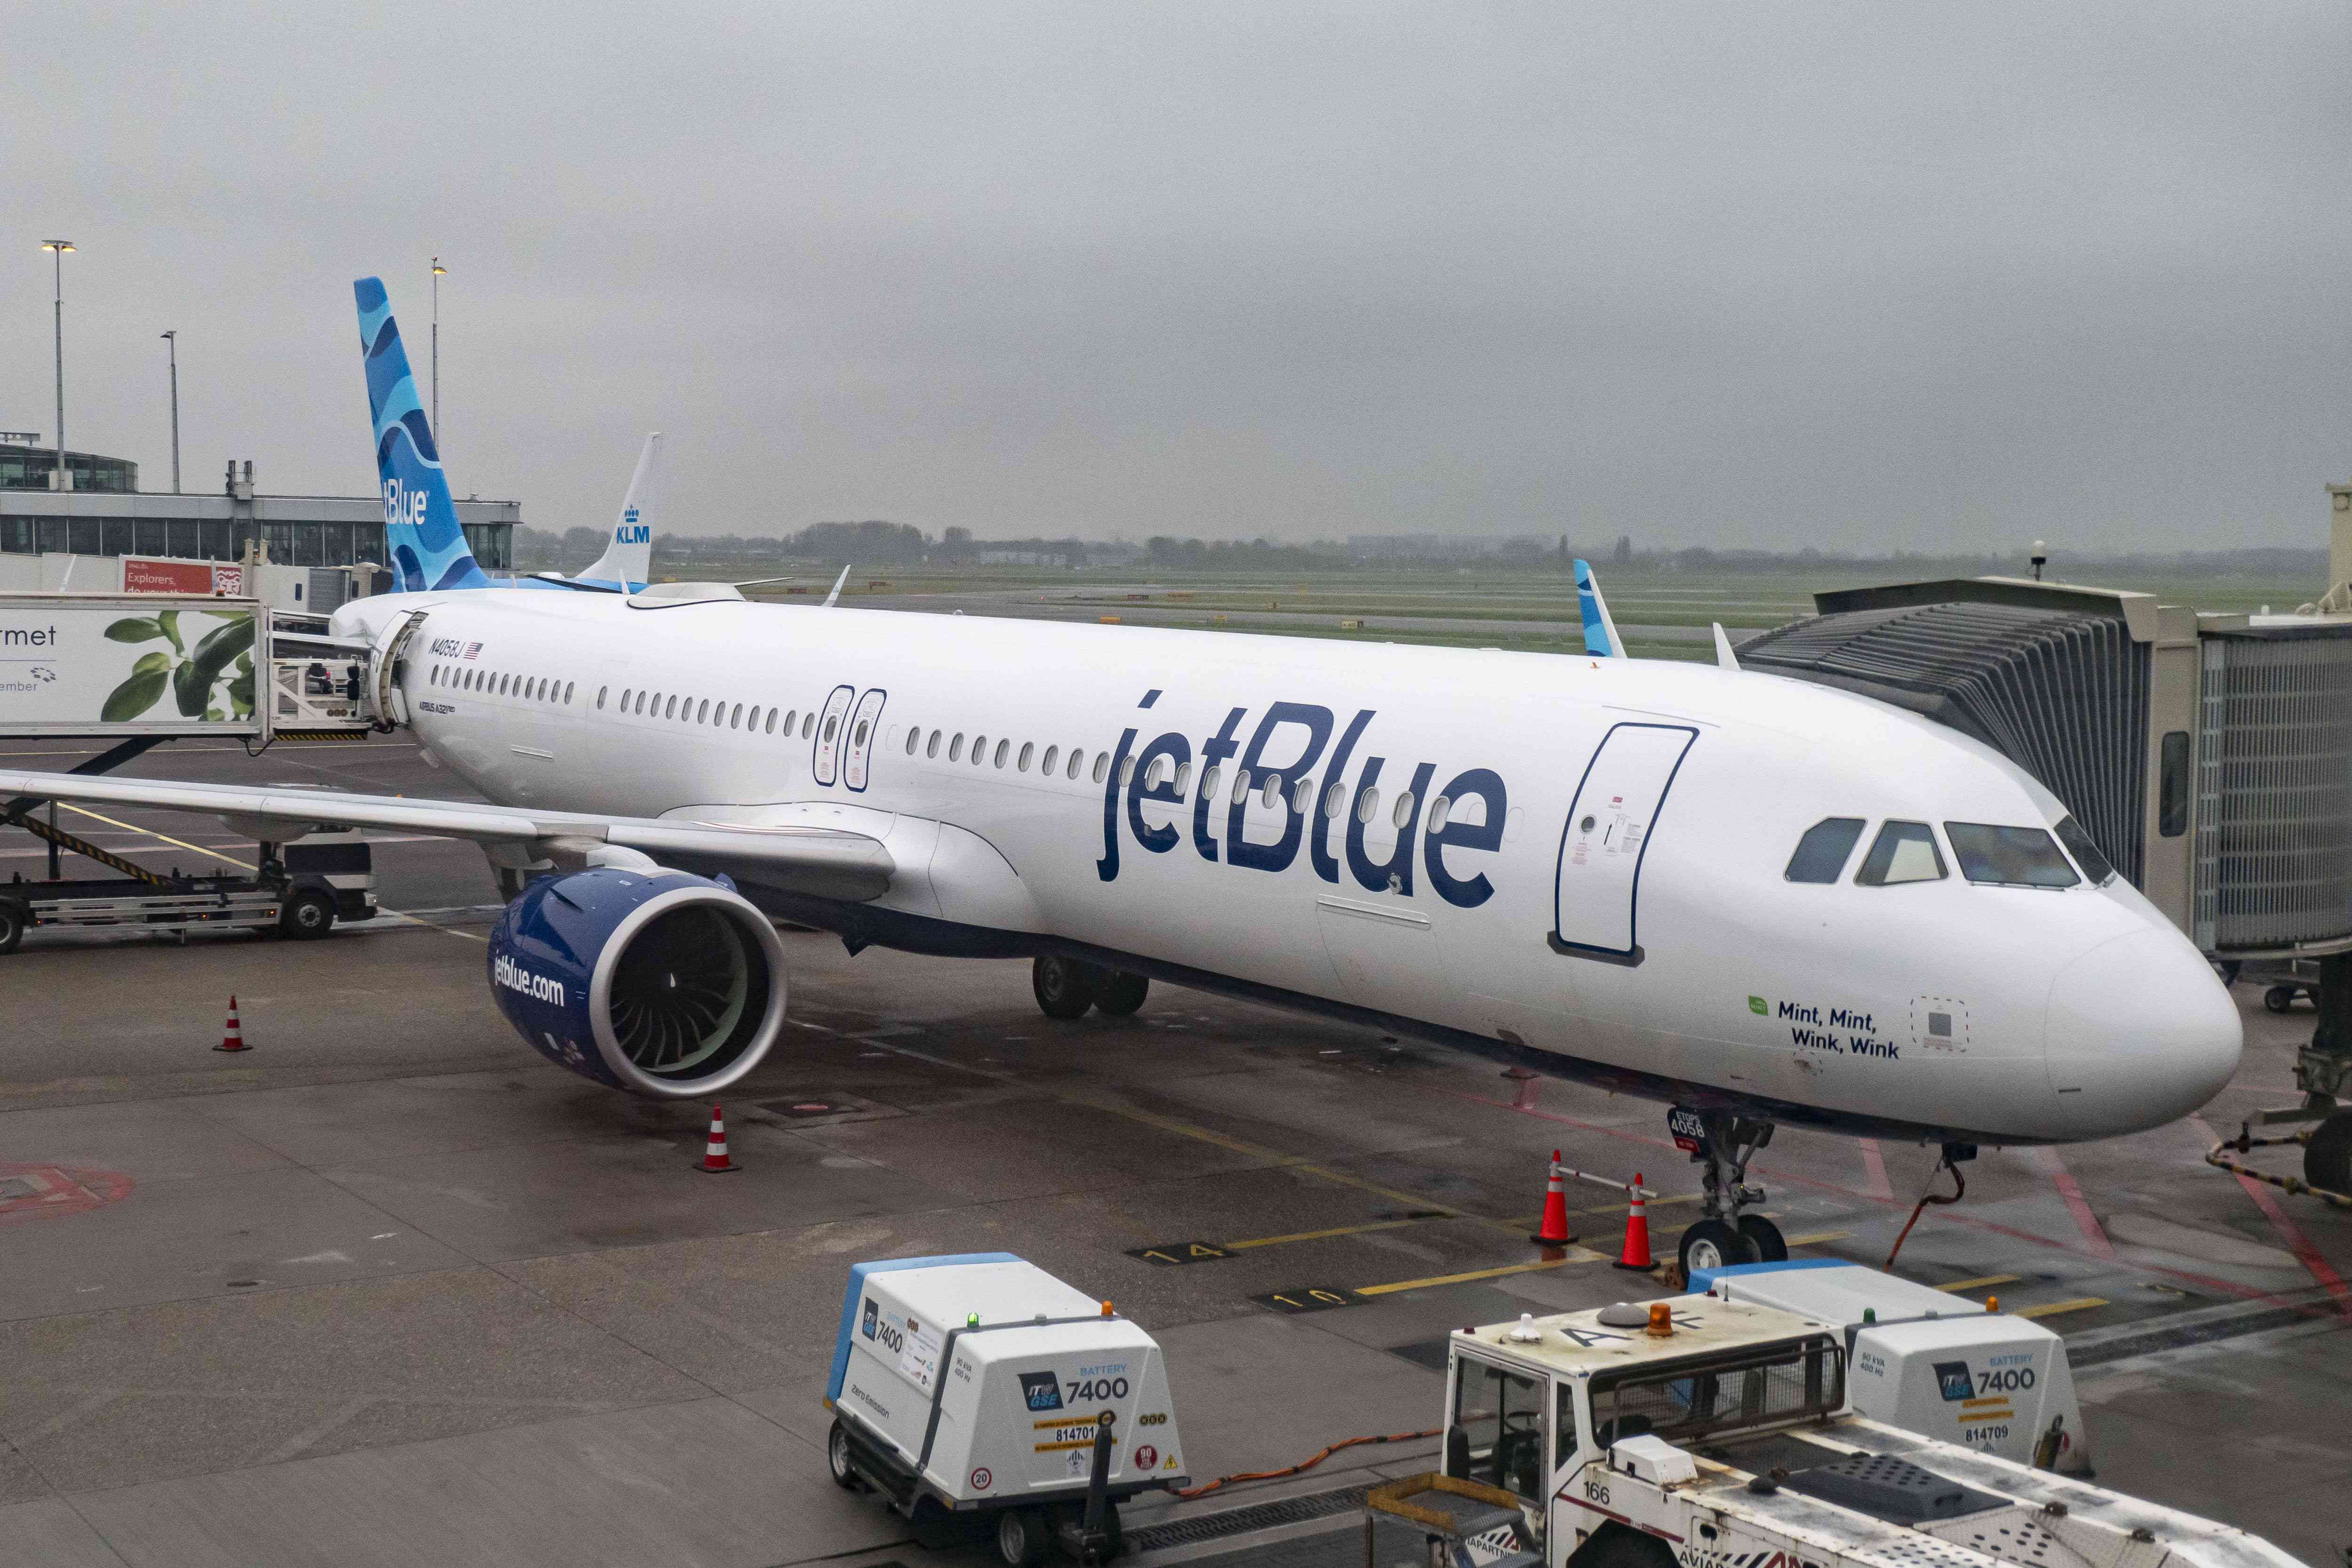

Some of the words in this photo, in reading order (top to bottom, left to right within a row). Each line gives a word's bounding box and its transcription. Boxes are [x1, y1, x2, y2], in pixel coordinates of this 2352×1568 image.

[617, 526, 650, 544] KLM
[128, 573, 176, 586] Explorers,
[0, 626, 56, 645] met
[428, 638, 466, 658] N4058J
[1096, 689, 1507, 908] jetBlue
[495, 949, 564, 1006] jetblue.com
[1779, 1001, 1822, 1027] Mint,
[1829, 1008, 1876, 1035] Mint,
[1792, 1027, 1843, 1054] Wink,
[1850, 1036, 1899, 1059] Wink
[1671, 1118, 1705, 1138] 4058
[877, 1321, 902, 1353] 7400
[1080, 1363, 1127, 1377] BATTERY
[1028, 1384, 1054, 1397] ITW
[1066, 1377, 1128, 1403] 7400
[1978, 1368, 2035, 1393] 7400
[851, 1384, 865, 1400] Zero
[1030, 1393, 1058, 1407] GSE
[1057, 1426, 1094, 1442] 814701
[1966, 1425, 2008, 1441] 814709
[976, 1473, 987, 1483] 20
[1584, 1481, 1610, 1504] 166
[1467, 1537, 1509, 1559] IAPARTN
